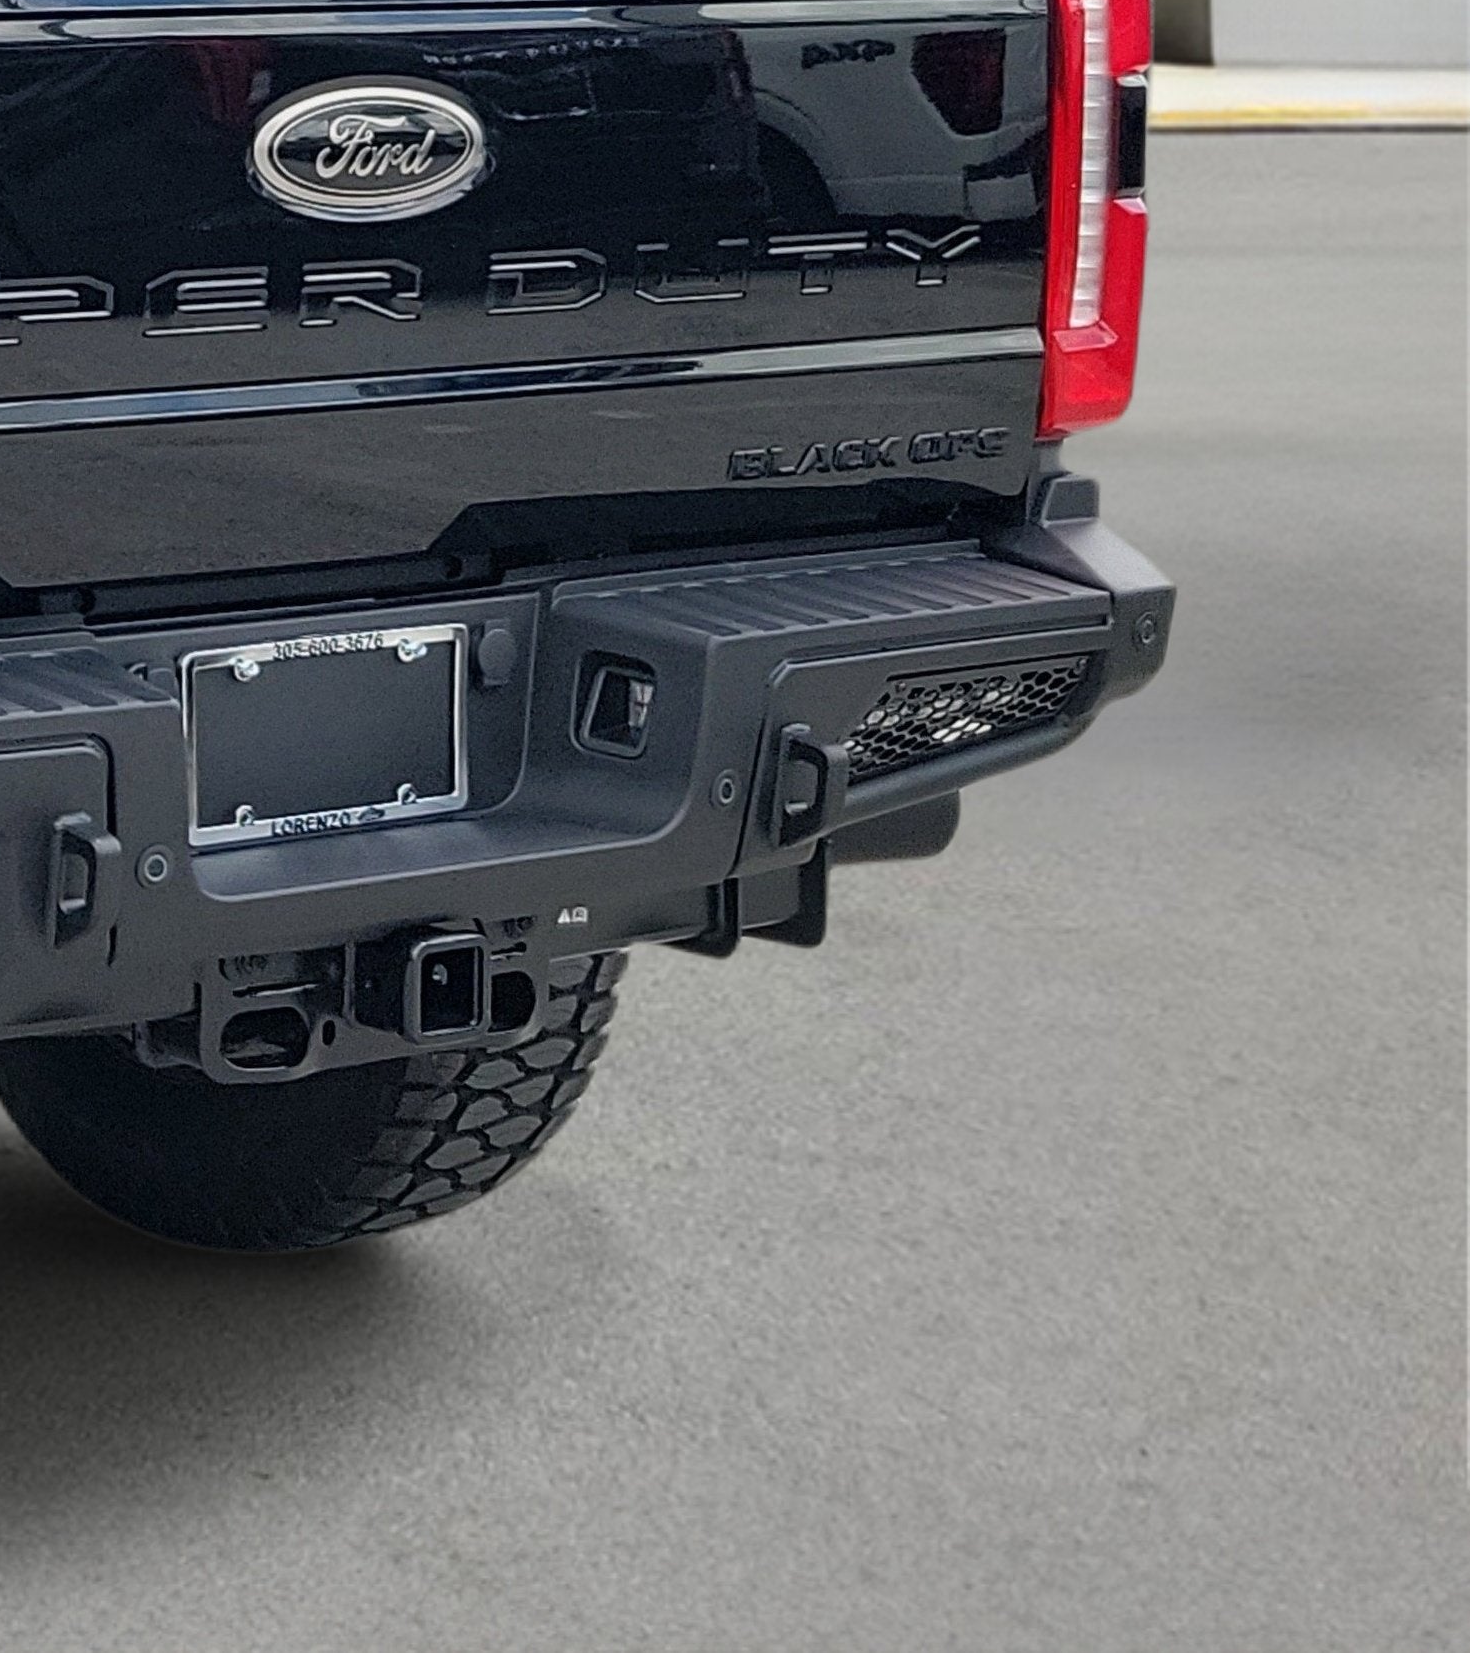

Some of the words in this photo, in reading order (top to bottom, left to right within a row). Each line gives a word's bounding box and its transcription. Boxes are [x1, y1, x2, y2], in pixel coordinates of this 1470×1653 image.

[315, 113, 436, 179] Ford
[486, 223, 981, 317] DUTY
[726, 435, 903, 480] BLACK
[271, 811, 351, 838] LORENZO
